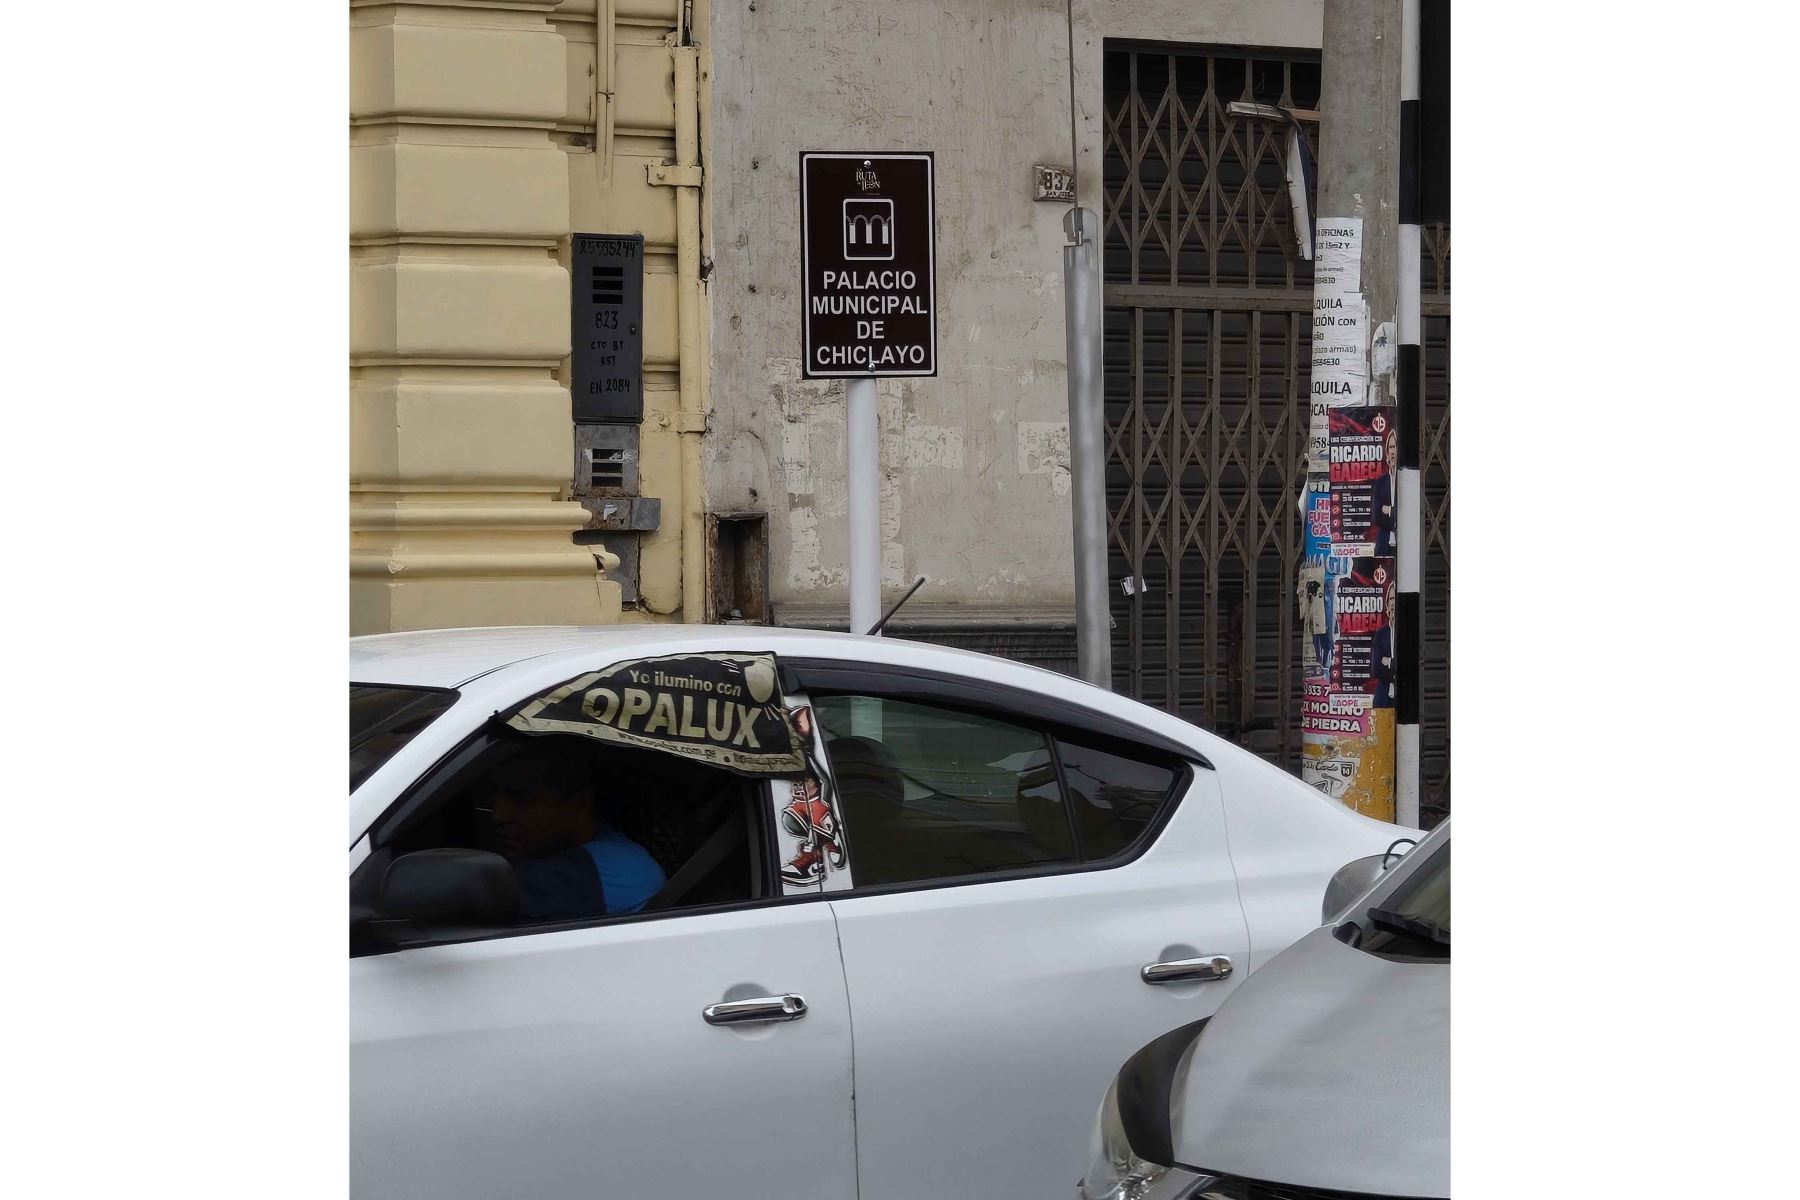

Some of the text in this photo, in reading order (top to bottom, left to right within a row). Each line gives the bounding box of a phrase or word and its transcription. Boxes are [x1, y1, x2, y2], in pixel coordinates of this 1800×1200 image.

[823, 271, 916, 290] PALACIO
[812, 296, 927, 315] MUNICIPAL
[595, 311, 618, 329] 823
[1338, 318, 1356, 326] CON
[857, 321, 884, 339] DE
[816, 345, 925, 365] CHICLAYO
[606, 378, 630, 392] 2084
[1330, 445, 1383, 463] RICARDO
[629, 669, 742, 697] Yo ilumino con
[581, 688, 762, 748] OPALUX
[1311, 702, 1364, 716] MOLINO
[1312, 718, 1361, 732] PIEDRA
